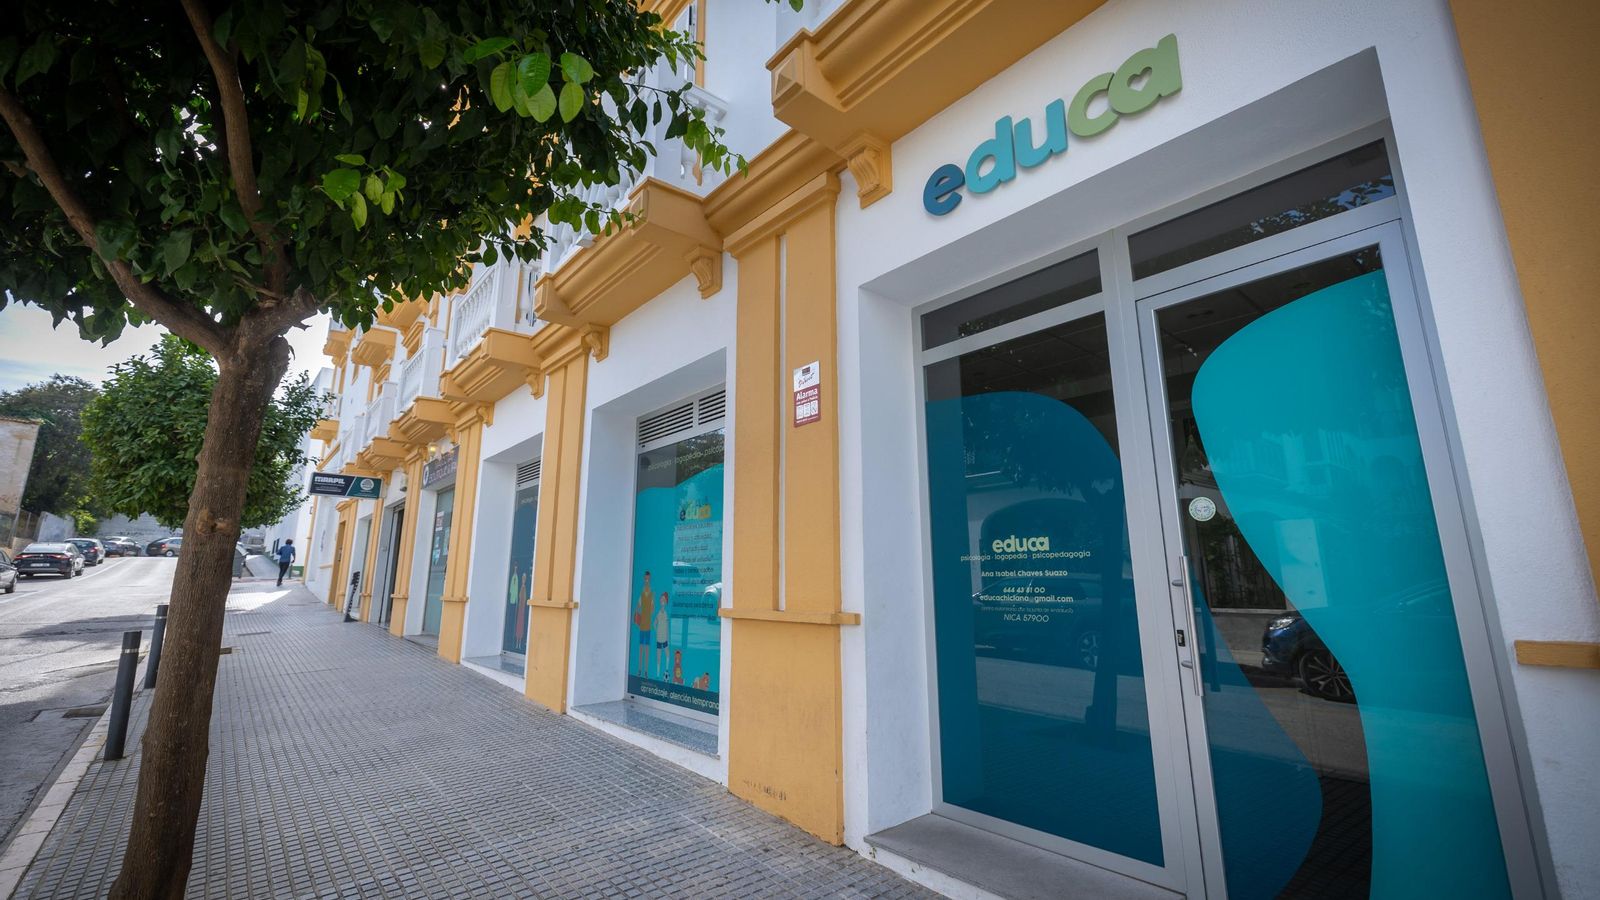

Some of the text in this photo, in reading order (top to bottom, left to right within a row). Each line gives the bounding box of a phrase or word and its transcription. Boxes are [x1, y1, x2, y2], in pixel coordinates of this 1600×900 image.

[923, 33, 1182, 216] educa
[796, 388, 818, 400] Alarma
[992, 535, 1050, 553] educa
[994, 552, 1028, 561] logopedia
[1023, 614, 1050, 622] 57900
